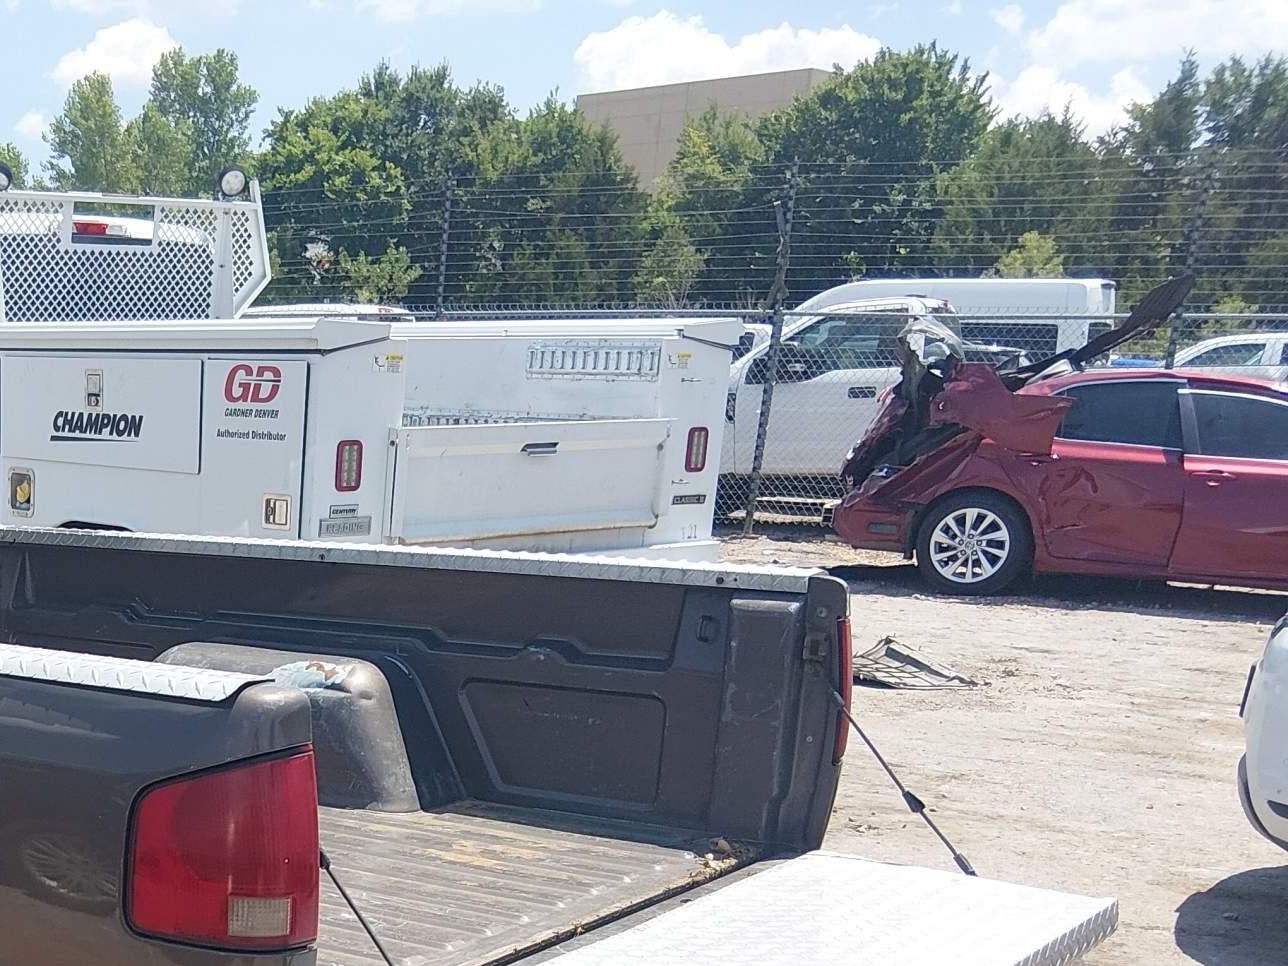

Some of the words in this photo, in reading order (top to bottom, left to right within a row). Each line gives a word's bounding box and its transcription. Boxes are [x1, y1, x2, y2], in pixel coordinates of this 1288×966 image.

[224, 364, 282, 403] GD
[224, 407, 253, 417] GARDNER
[254, 409, 280, 419] DENVER
[52, 410, 144, 438] CHAMPION
[216, 428, 250, 439] Authorized
[251, 430, 287, 441] Distributor
